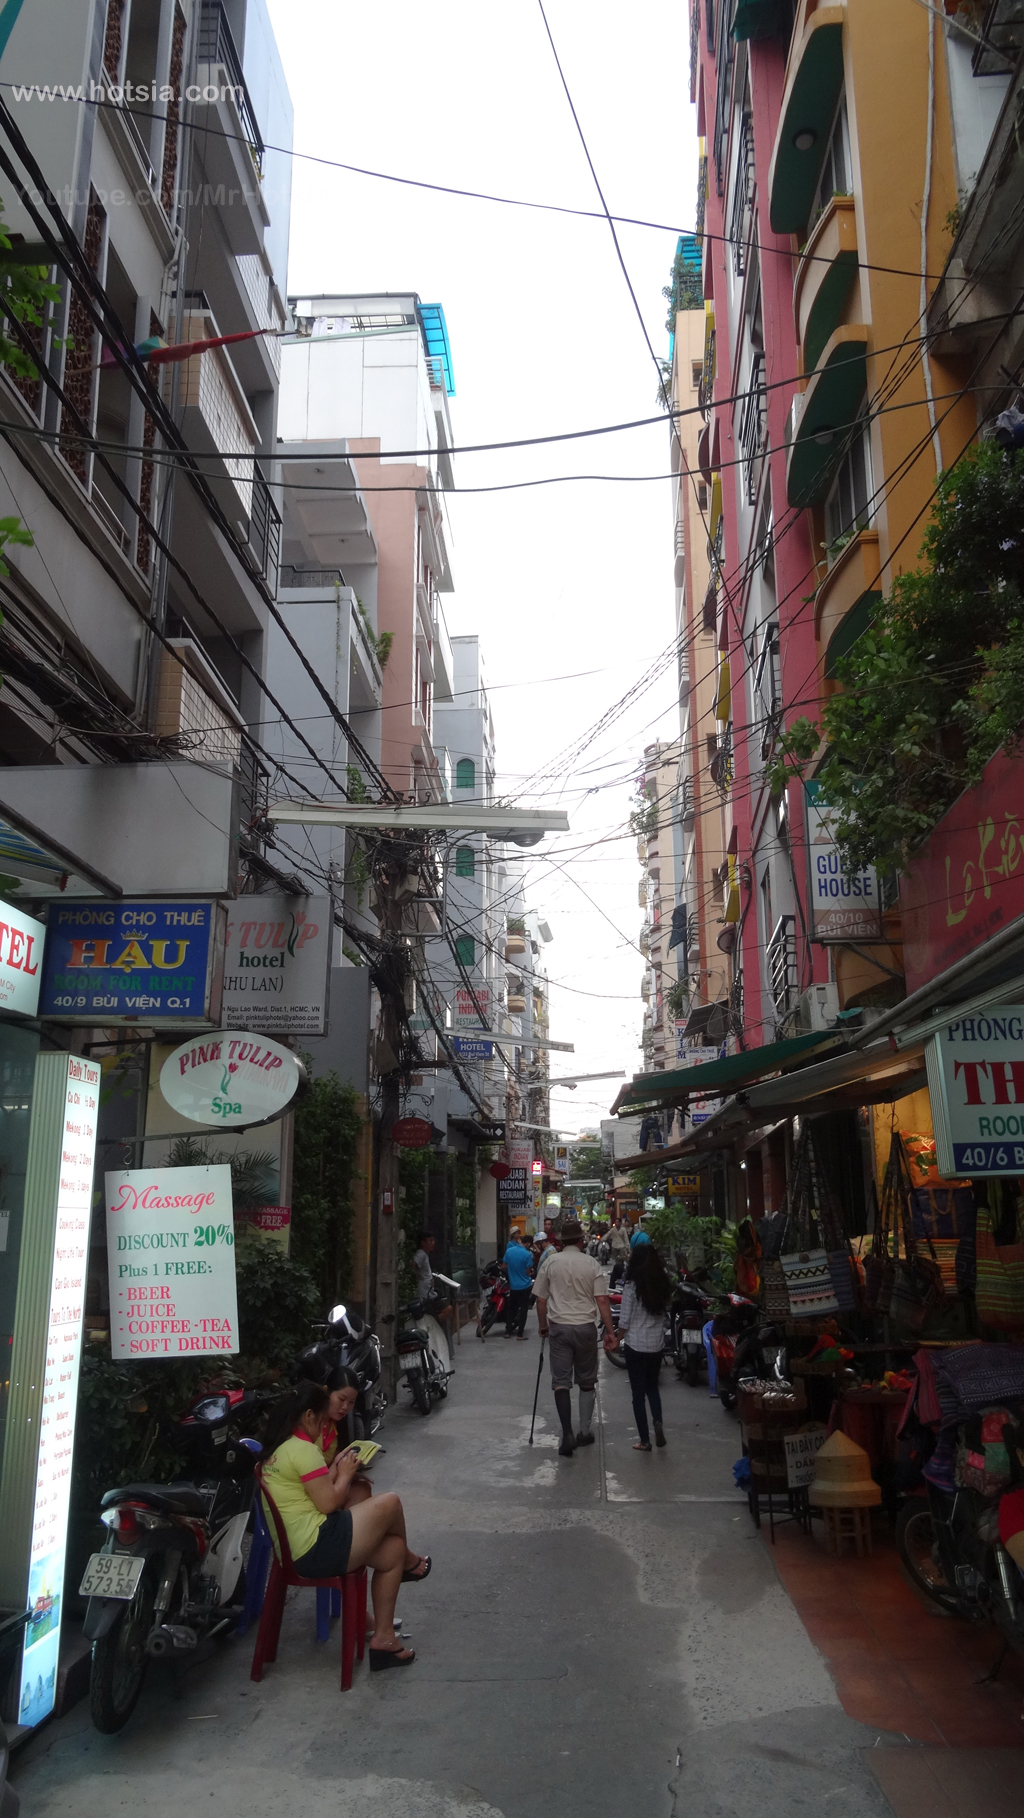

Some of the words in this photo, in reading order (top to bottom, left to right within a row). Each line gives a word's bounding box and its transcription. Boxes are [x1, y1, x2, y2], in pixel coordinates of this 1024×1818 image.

[818, 877, 872, 897] HOUSE
[58, 908, 115, 925] PHÒNG
[121, 911, 157, 925] CHO
[164, 909, 205, 925] THUÊ
[828, 913, 863, 923] 40/10
[238, 951, 285, 968] hotel
[53, 975, 103, 990] ROOM
[108, 975, 142, 991] FOR
[148, 975, 196, 991] RENT
[54, 996, 86, 1007] 40/9
[93, 994, 118, 1007] BÙI
[167, 997, 190, 1008] Q.1
[460, 1043, 486, 1051] HOTEL
[179, 1041, 223, 1076] PINK
[228, 1041, 283, 1071] TULIP
[69, 1060, 82, 1081] Daily
[84, 1064, 98, 1084] Tours
[211, 1097, 242, 1118] Spa
[962, 1146, 1008, 1169] 40/6
[499, 1180, 525, 1189] INDIAN
[672, 1176, 697, 1185] KIM
[111, 1184, 215, 1214] Massage
[261, 1215, 283, 1227] FREE
[117, 1232, 189, 1251] DISCOUNT
[194, 1223, 234, 1247] 20%
[118, 1264, 148, 1278] Plus
[153, 1263, 160, 1275] 1
[164, 1260, 212, 1276] FREE:
[127, 1286, 171, 1301] BEER
[127, 1303, 176, 1318] JUICE
[128, 1320, 191, 1334] COFFEE
[130, 1338, 171, 1353] SOFT
[178, 1336, 232, 1351] DRINK
